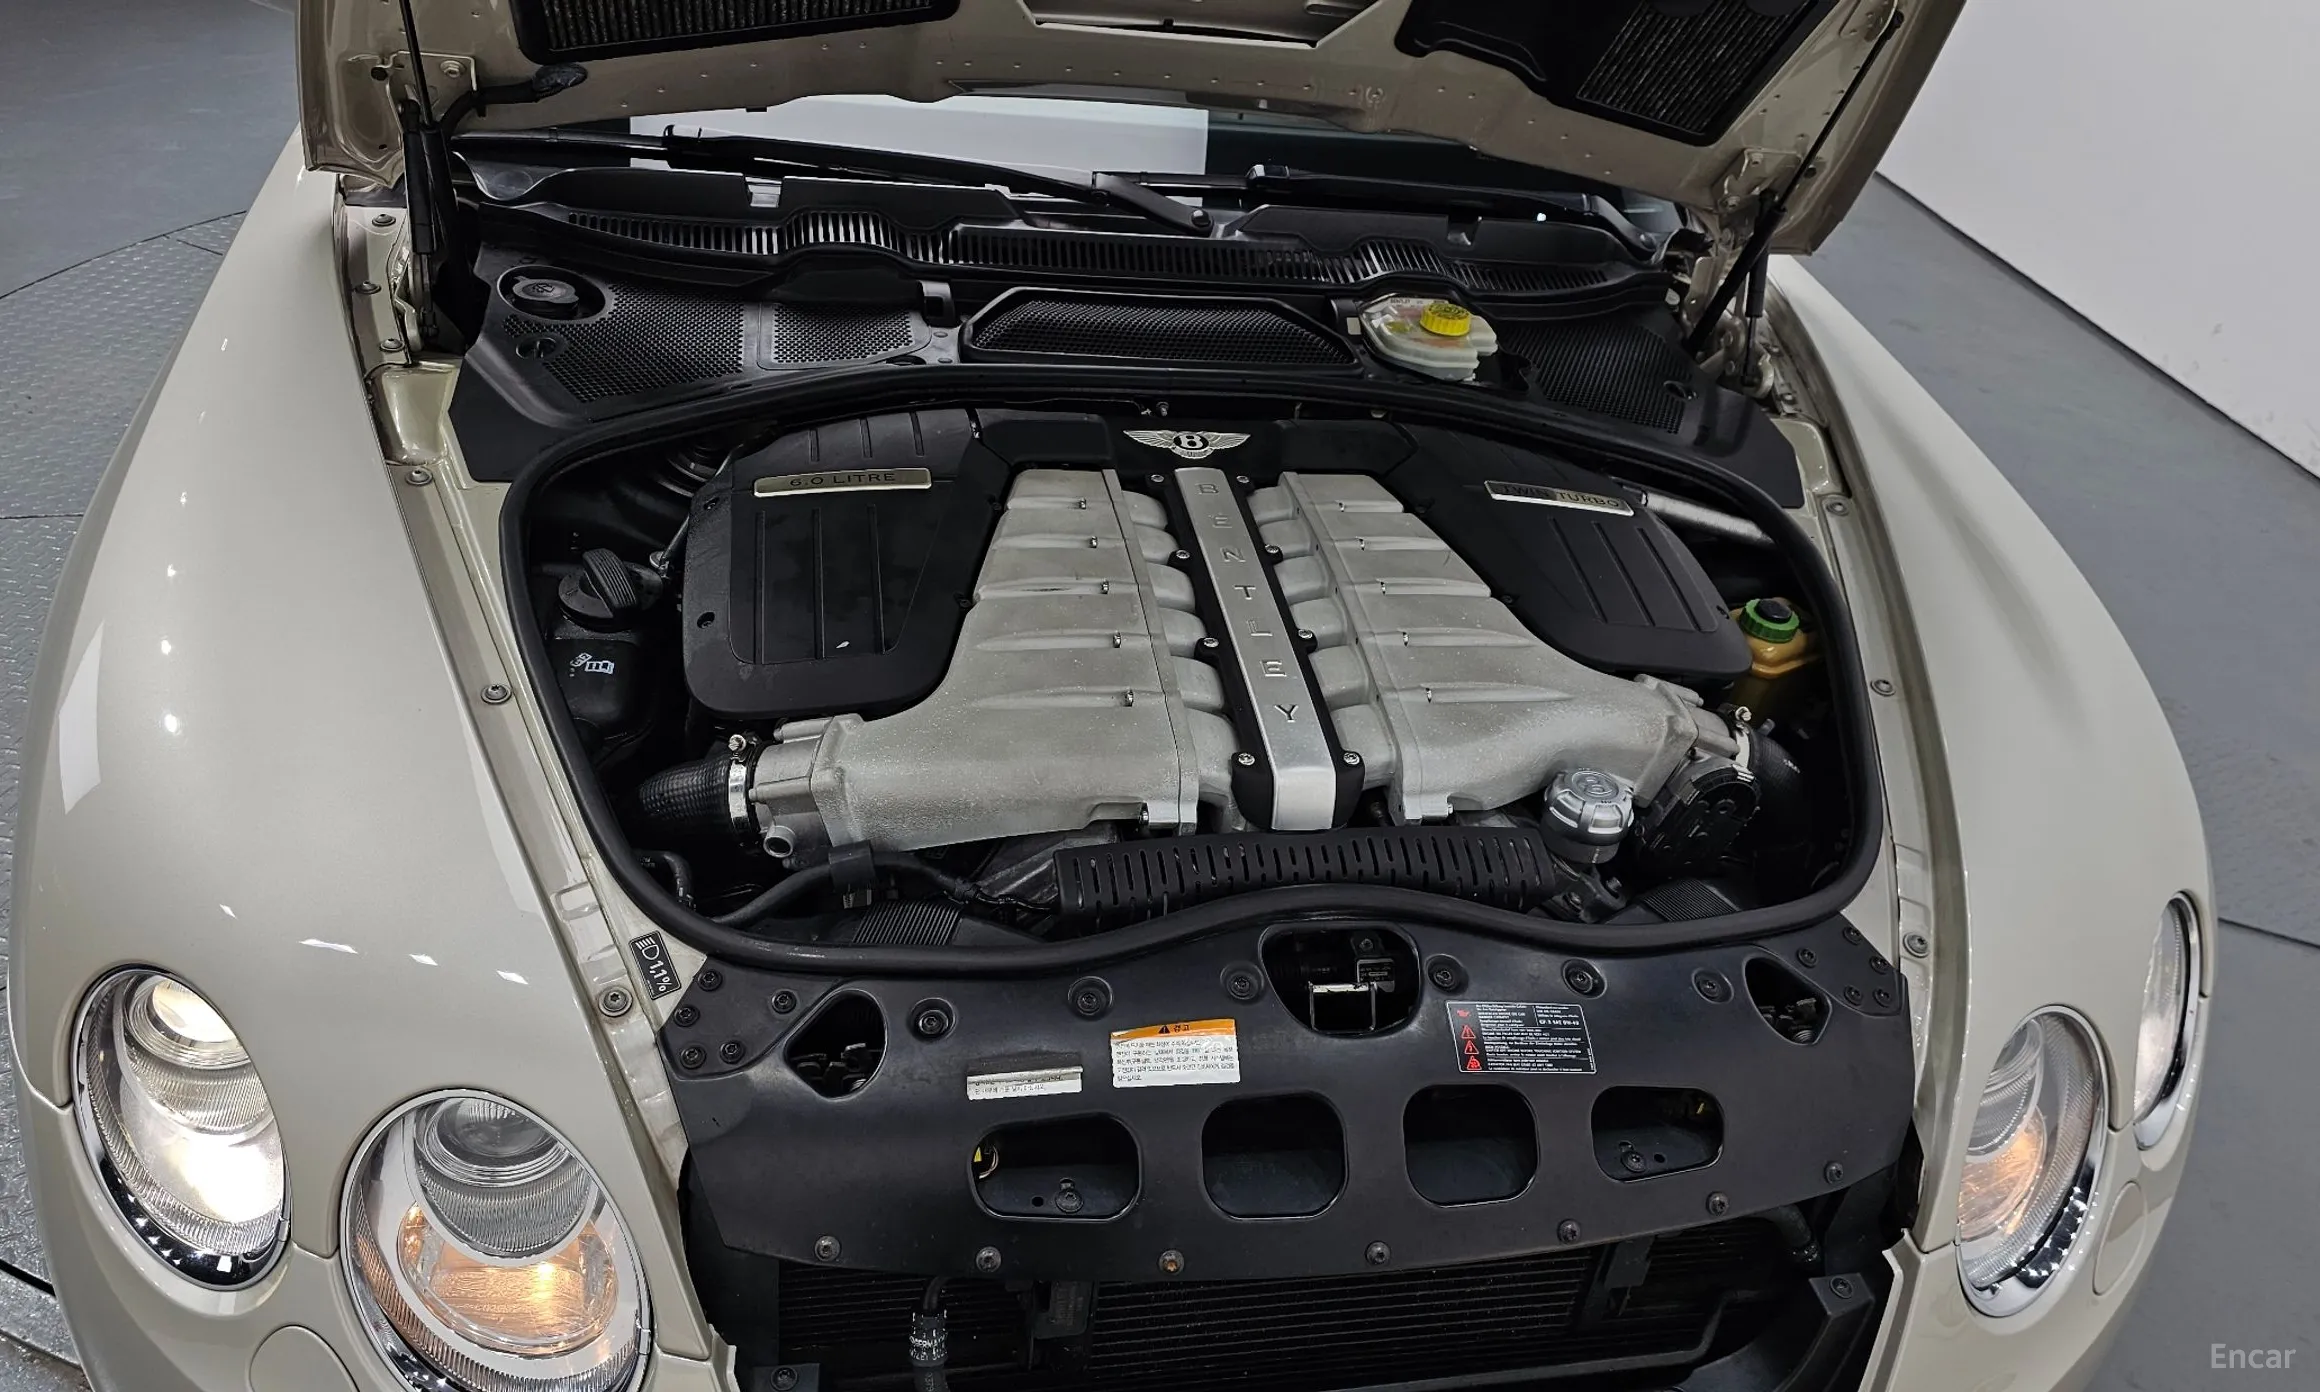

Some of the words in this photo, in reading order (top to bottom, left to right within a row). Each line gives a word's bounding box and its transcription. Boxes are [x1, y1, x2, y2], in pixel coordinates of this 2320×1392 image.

[790, 476, 824, 487] 6.0
[833, 473, 896, 484] LITRE
[1502, 485, 1550, 498] TWIN
[1558, 492, 1620, 507] TURBO
[1195, 482, 1299, 723] BENTLEY
[649, 960, 673, 992] 1,1%
